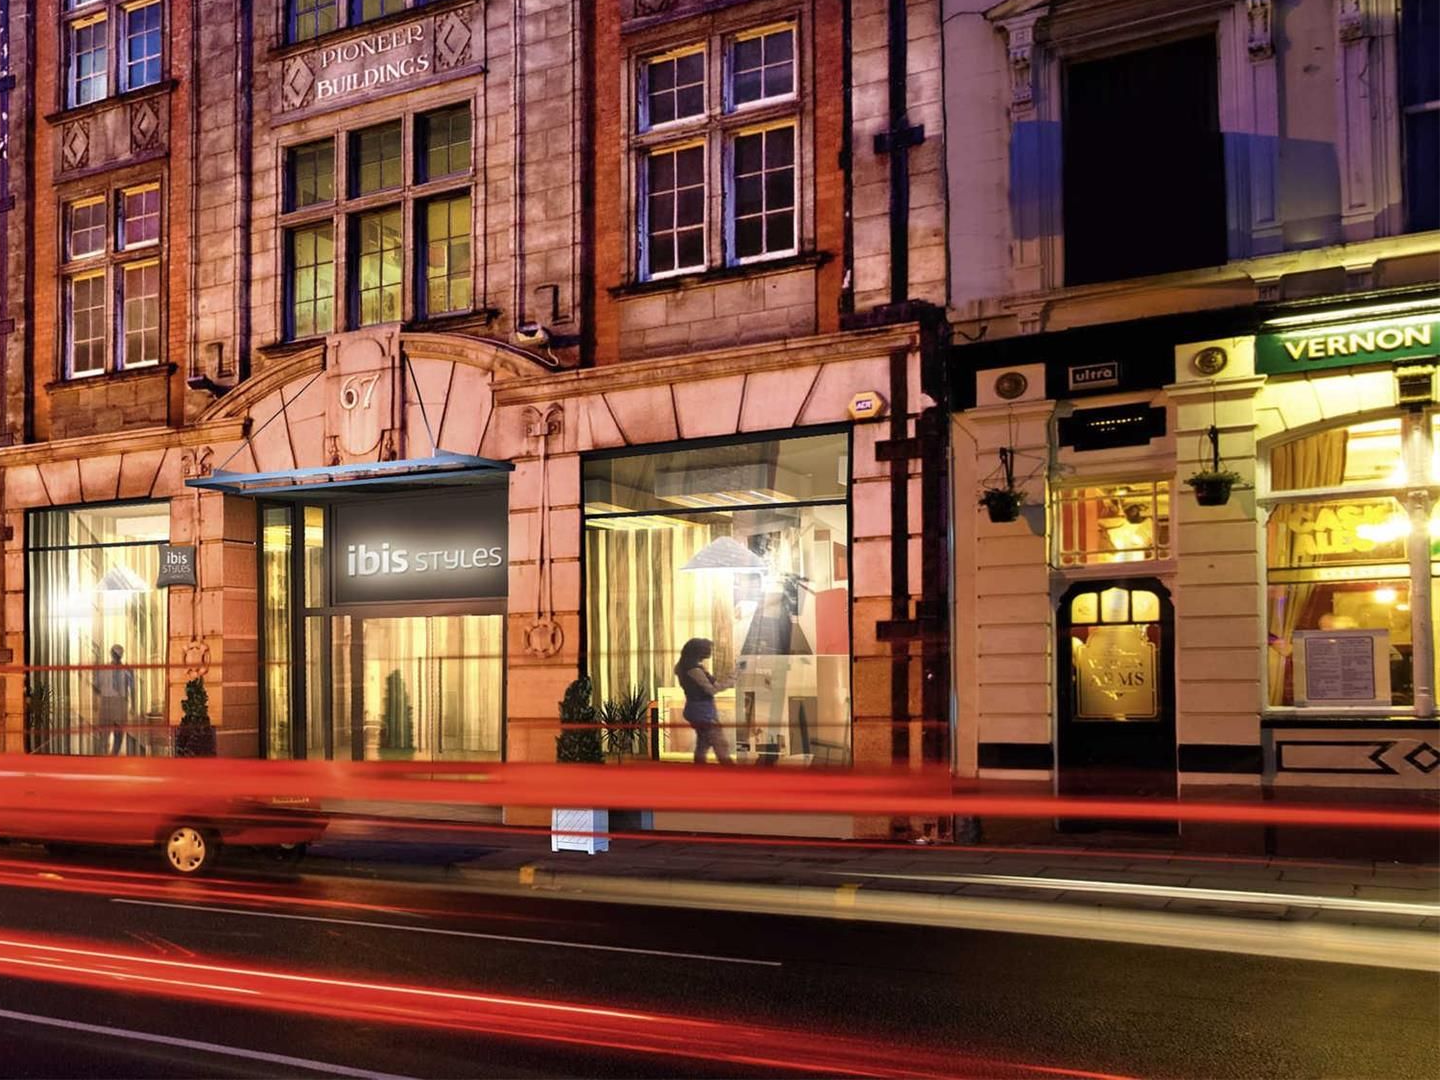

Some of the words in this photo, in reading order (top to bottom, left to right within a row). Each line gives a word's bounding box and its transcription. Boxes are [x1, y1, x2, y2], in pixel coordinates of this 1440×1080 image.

[322, 25, 424, 68] PIONEER
[317, 54, 430, 99] BUILDINGS
[1285, 324, 1432, 360] VERNON
[340, 374, 380, 409] 67
[1076, 369, 1112, 381] ultra
[167, 551, 188, 565] ibis
[347, 543, 409, 577] ibis
